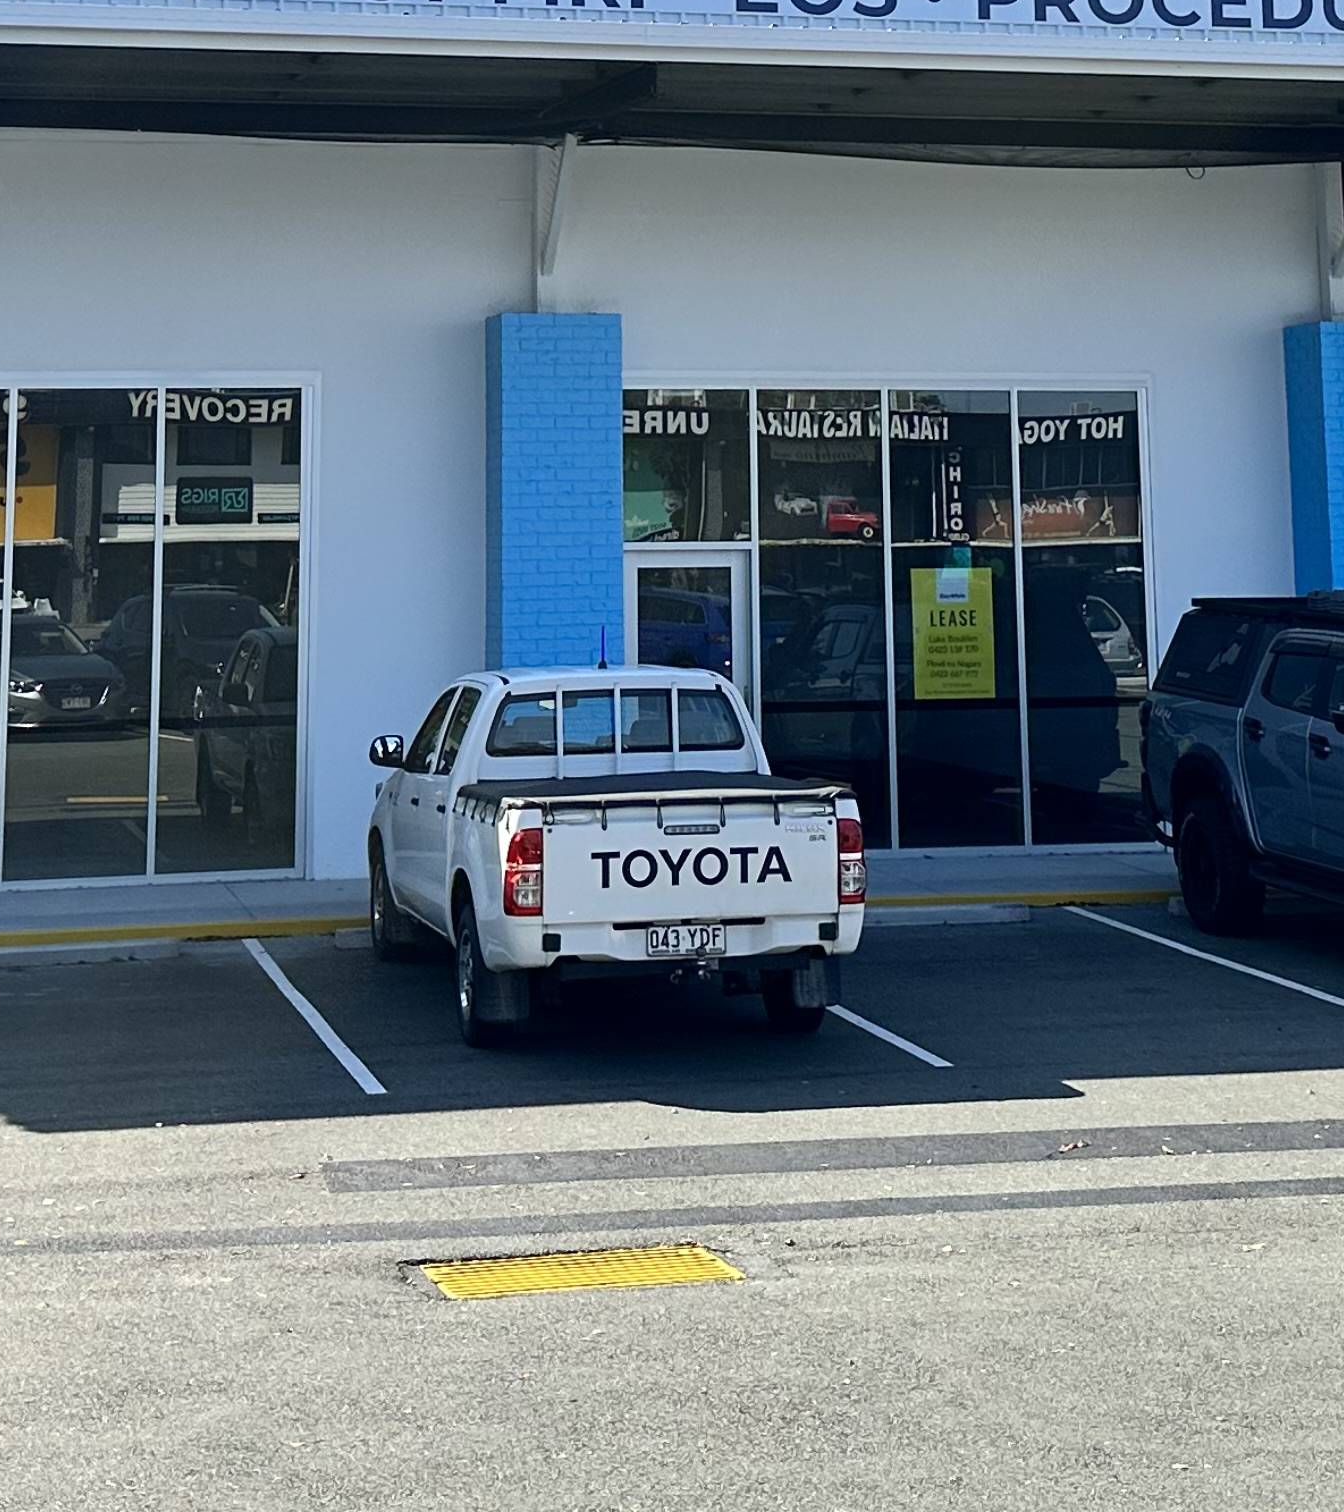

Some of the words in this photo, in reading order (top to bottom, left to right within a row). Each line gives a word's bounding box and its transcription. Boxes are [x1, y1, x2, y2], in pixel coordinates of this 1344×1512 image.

[930, 610, 977, 627] LEASE
[591, 846, 792, 888] TOYOTA
[650, 929, 680, 948] 043
[687, 928, 722, 947] YDF
